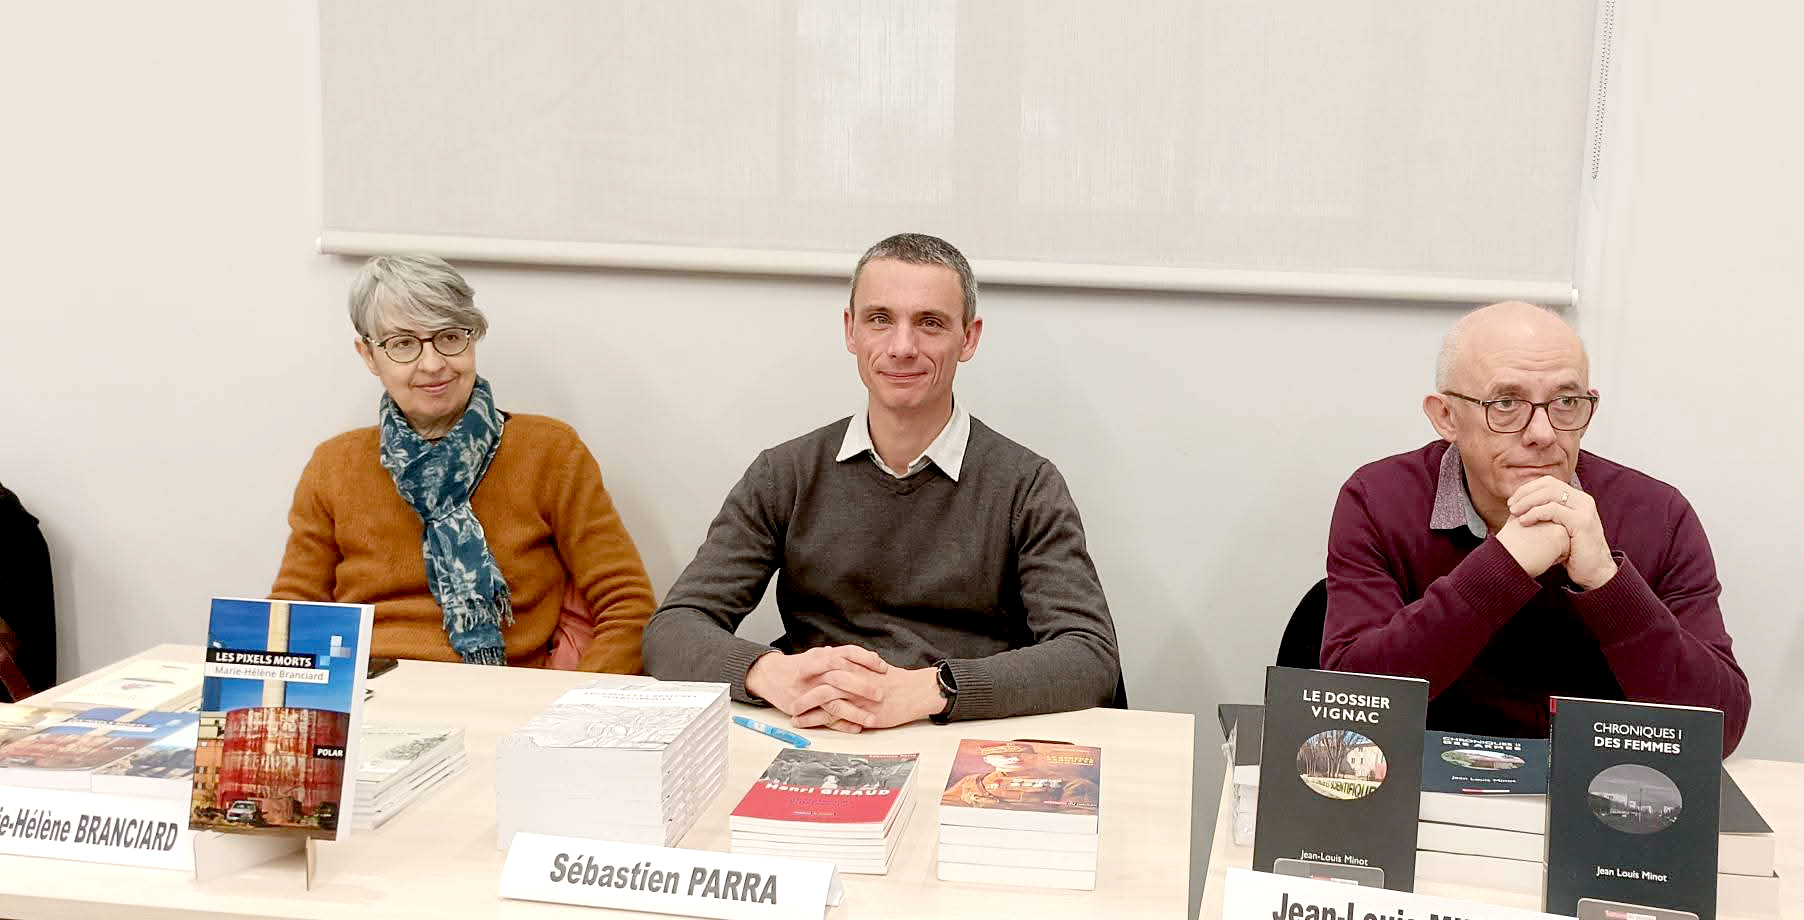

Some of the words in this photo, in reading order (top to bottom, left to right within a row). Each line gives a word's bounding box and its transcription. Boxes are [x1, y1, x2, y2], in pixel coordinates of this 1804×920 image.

[215, 652, 236, 663] LES
[236, 653, 272, 665] PIXELS
[273, 656, 312, 667] MORTS
[215, 665, 277, 677] Marie-Hélène
[279, 671, 324, 681] Branciard
[1303, 689, 1321, 702] LE
[1325, 691, 1390, 709] DOSSIER
[1311, 705, 1380, 724] VIGNAC
[1593, 721, 1675, 739] CHRONIQUES
[317, 748, 344, 757] POLAR
[1594, 736, 1621, 749] DES
[1624, 739, 1681, 754] FEMMES
[765, 783, 816, 794] Henri
[820, 788, 891, 797] GIRAUD
[74, 814, 179, 851] BRANCIARD
[1300, 849, 1342, 864] Jean-Louis
[1344, 854, 1369, 866] Minot
[549, 853, 680, 895] Sébastien
[687, 866, 777, 905] PARRA
[1596, 865, 1615, 877] Jean
[1616, 867, 1640, 880] Louis
[1641, 871, 1668, 883] Minot
